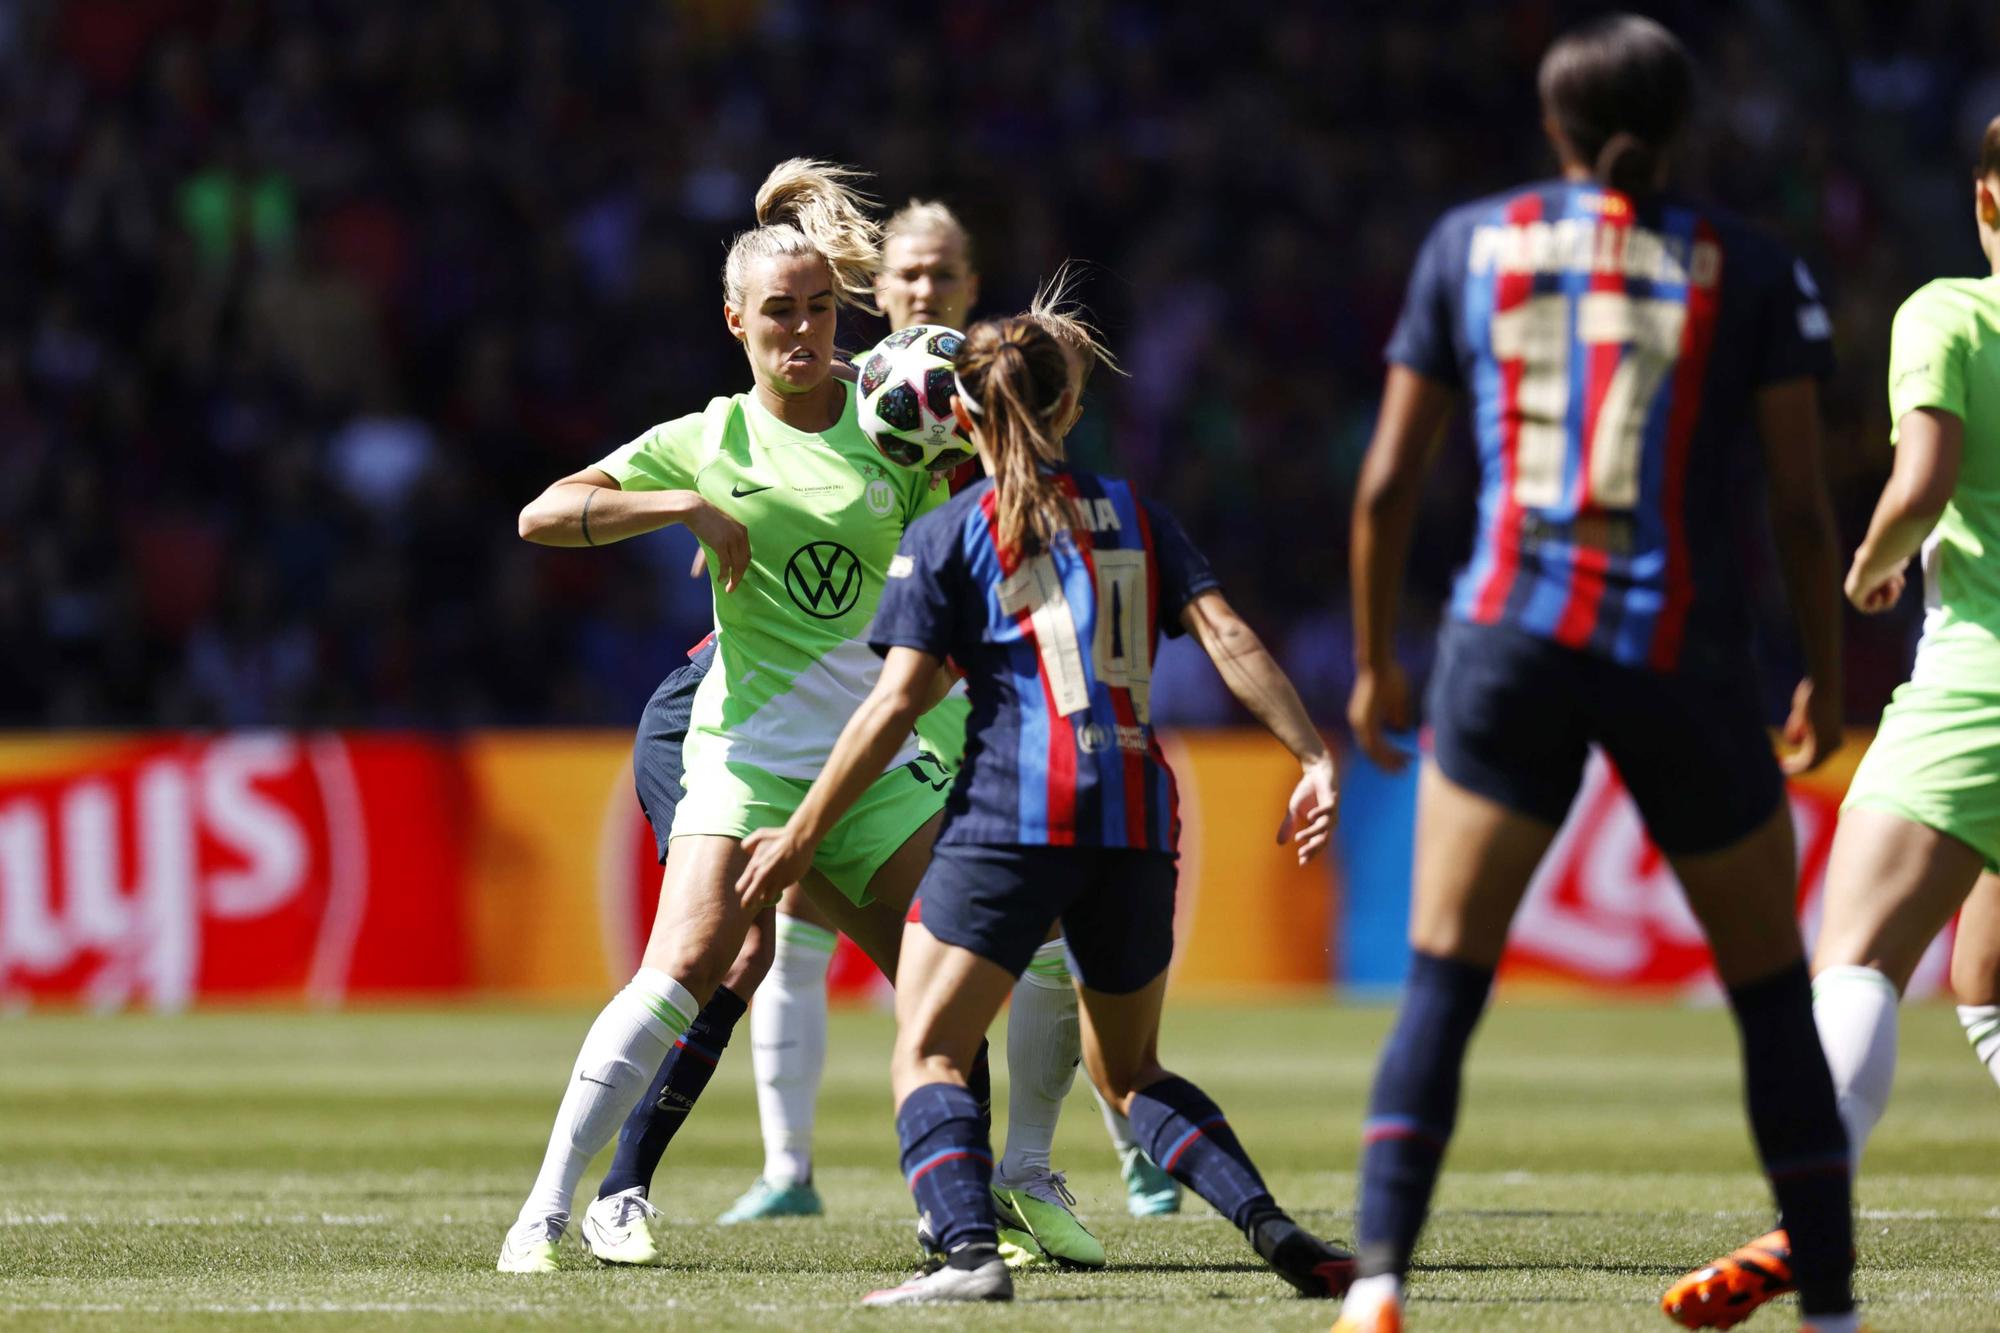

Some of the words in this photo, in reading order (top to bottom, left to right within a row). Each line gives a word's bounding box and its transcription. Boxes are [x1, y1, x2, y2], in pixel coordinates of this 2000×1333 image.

[1492, 292, 1687, 510] 17
[1073, 497, 1122, 532] NA
[994, 549, 1153, 726] 14
